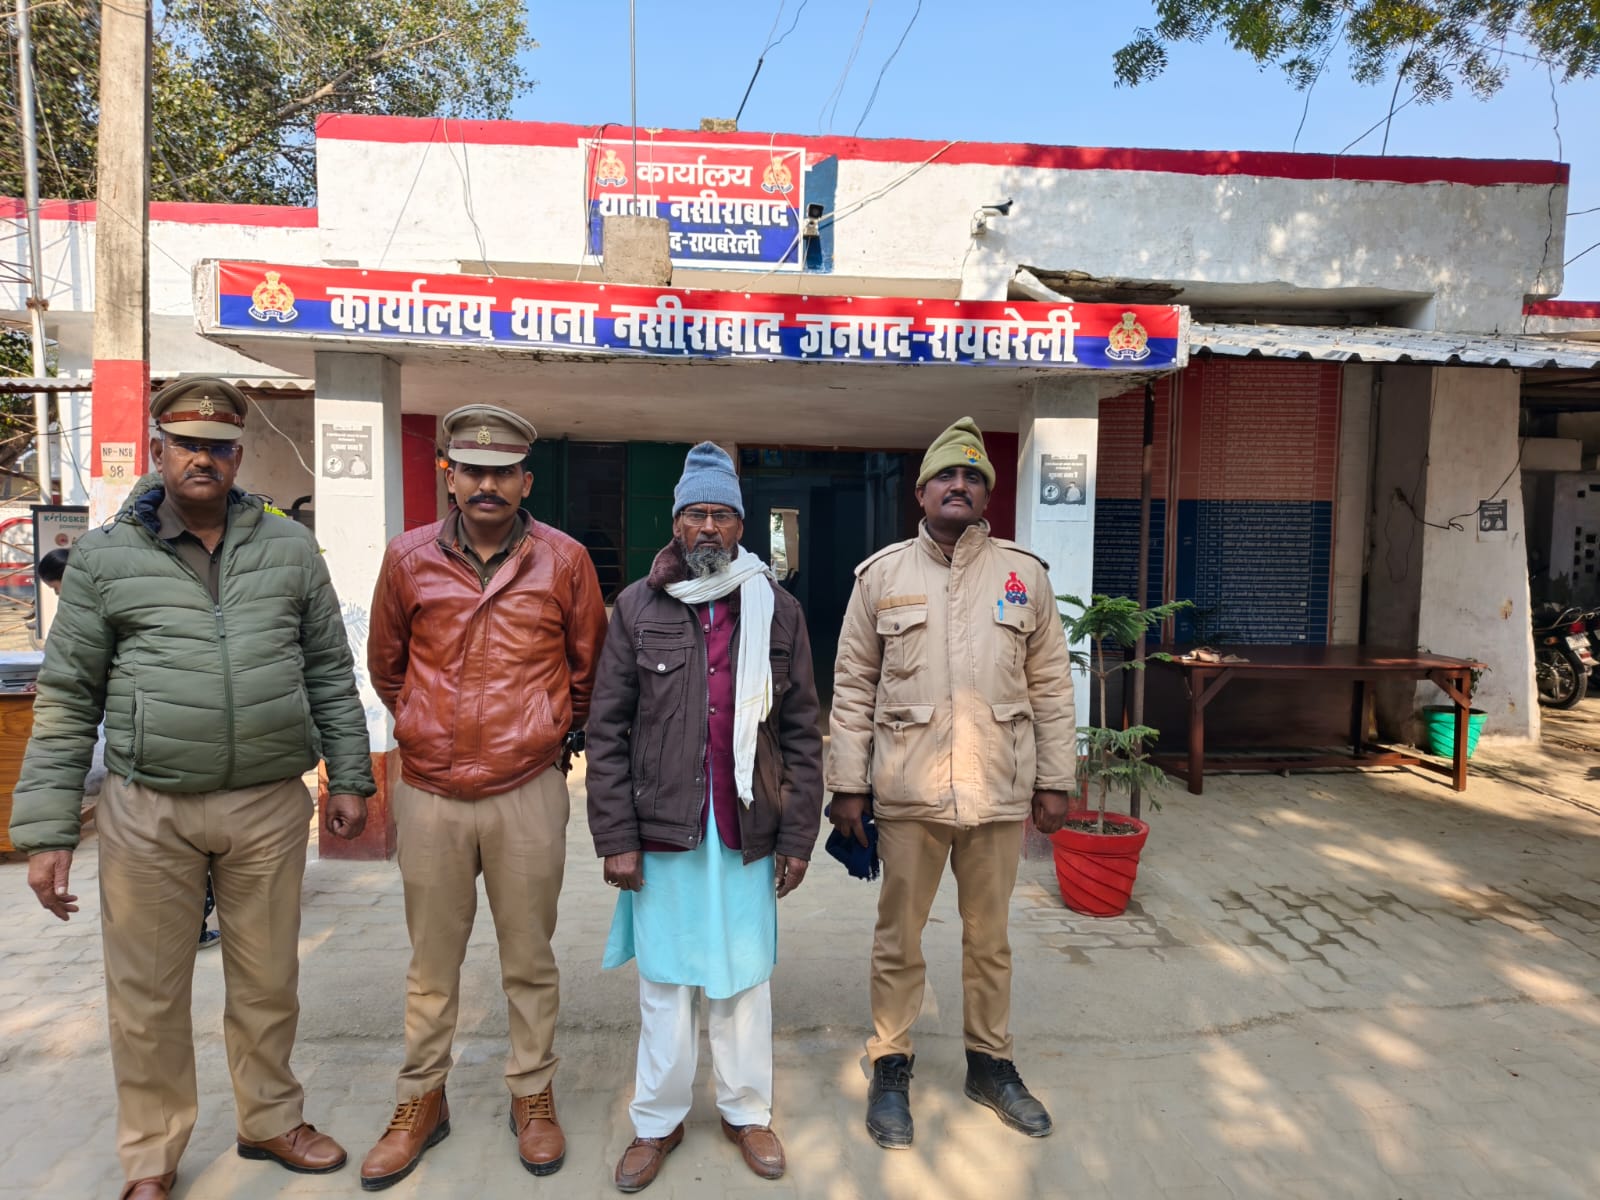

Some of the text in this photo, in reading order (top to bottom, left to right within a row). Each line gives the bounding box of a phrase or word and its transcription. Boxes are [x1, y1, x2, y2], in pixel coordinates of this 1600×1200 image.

[636, 155, 753, 187] कार्यालय
[599, 189, 789, 227] थाना नसीराबाद
[669, 228, 762, 255] द-रायबरेली
[326, 279, 497, 339] कार्यालय
[511, 297, 599, 344] थाना
[611, 295, 785, 353] नसीराबाद
[110, 465, 124, 478] 98
